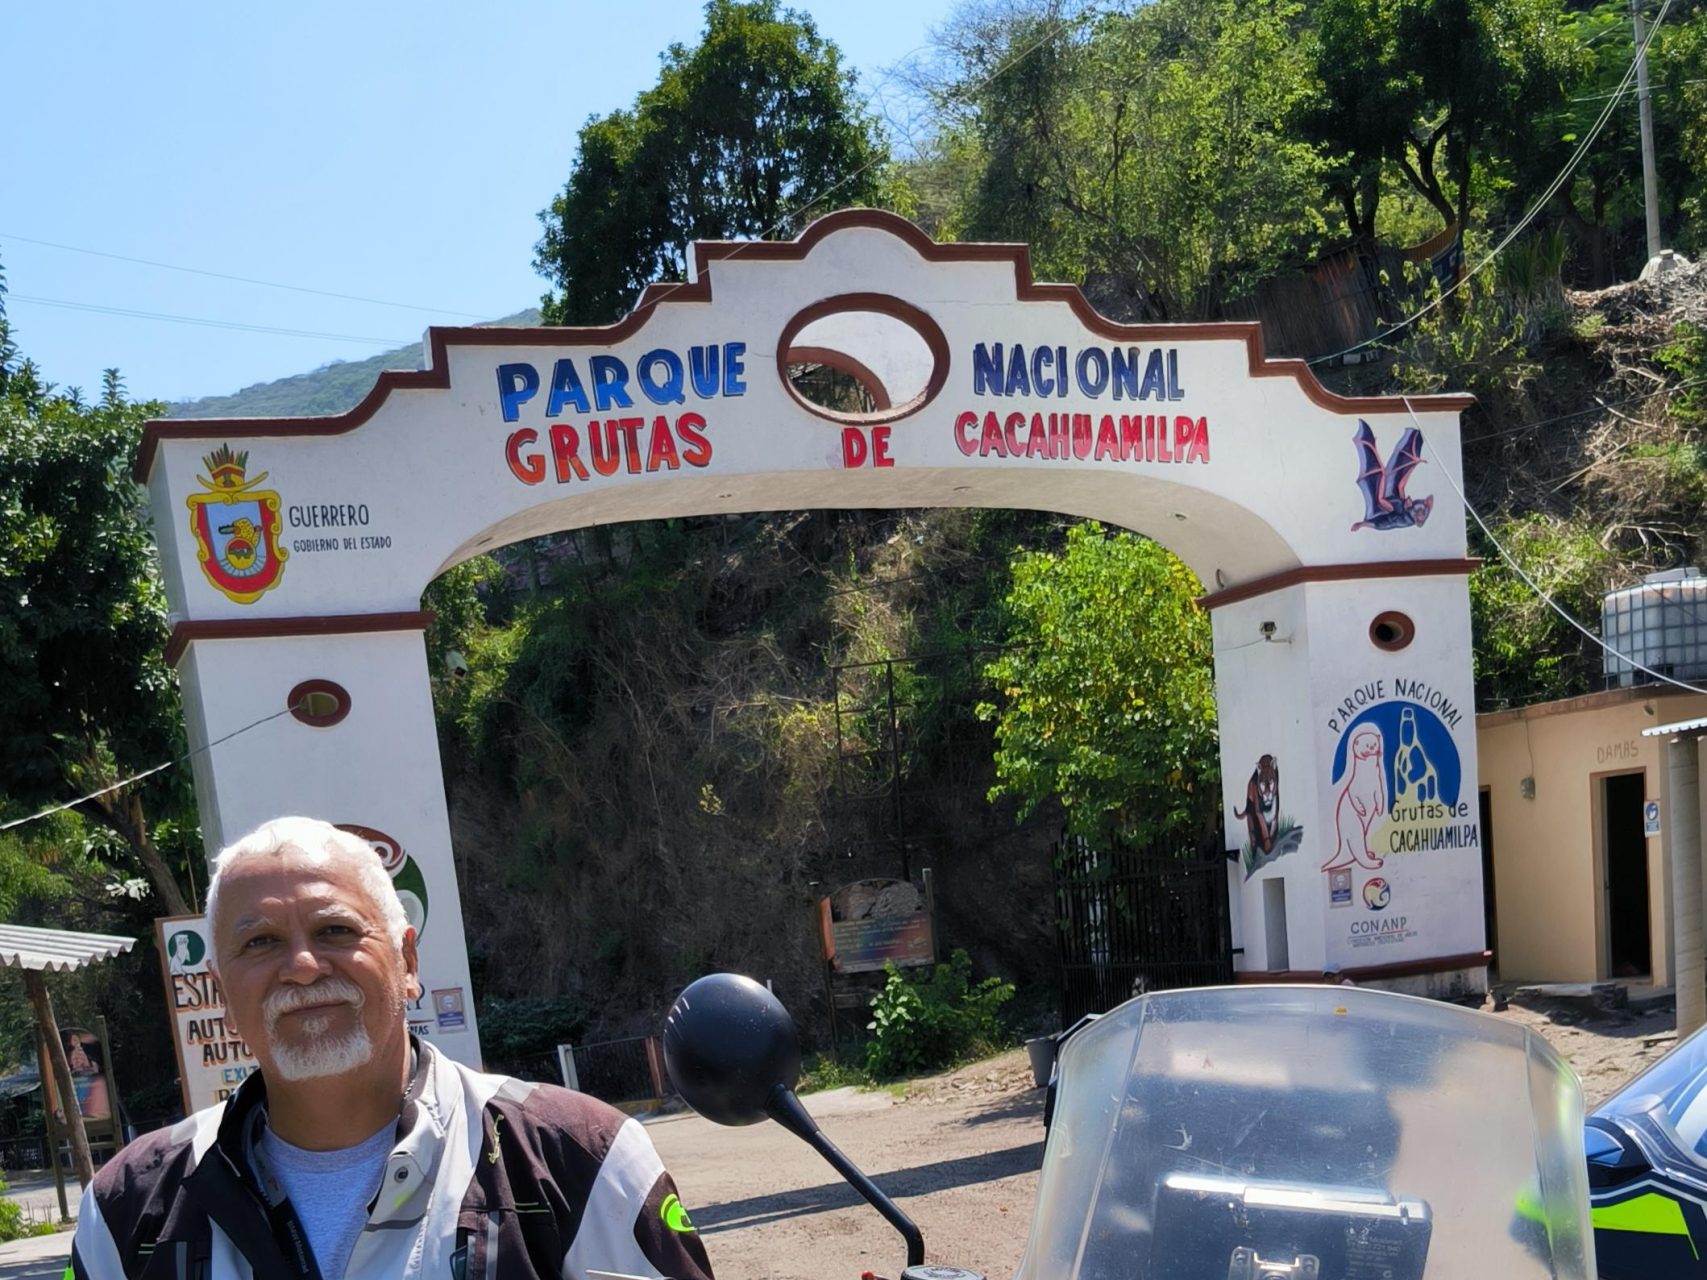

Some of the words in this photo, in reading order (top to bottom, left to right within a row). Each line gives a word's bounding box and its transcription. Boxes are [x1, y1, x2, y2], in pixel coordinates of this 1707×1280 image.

[497, 341, 748, 422] PARQUE
[973, 342, 1186, 402] NACIONAL
[505, 411, 714, 486] GRUTAS
[841, 426, 895, 468] DE
[954, 411, 1211, 465] CACAHUAMILPA
[289, 504, 369, 528] GUERRERO
[293, 538, 339, 553] GOBIERNO
[343, 536, 358, 550] DEL
[361, 535, 392, 550] ESTADO
[1328, 680, 1385, 733] PARQUE
[1395, 678, 1463, 731] NACIONAL
[1596, 740, 1640, 764] DAMAS
[1391, 800, 1444, 823] Grutas
[1448, 799, 1469, 818] de
[1390, 824, 1479, 854] CACAHUAMILPA
[1350, 916, 1407, 934] CONANP
